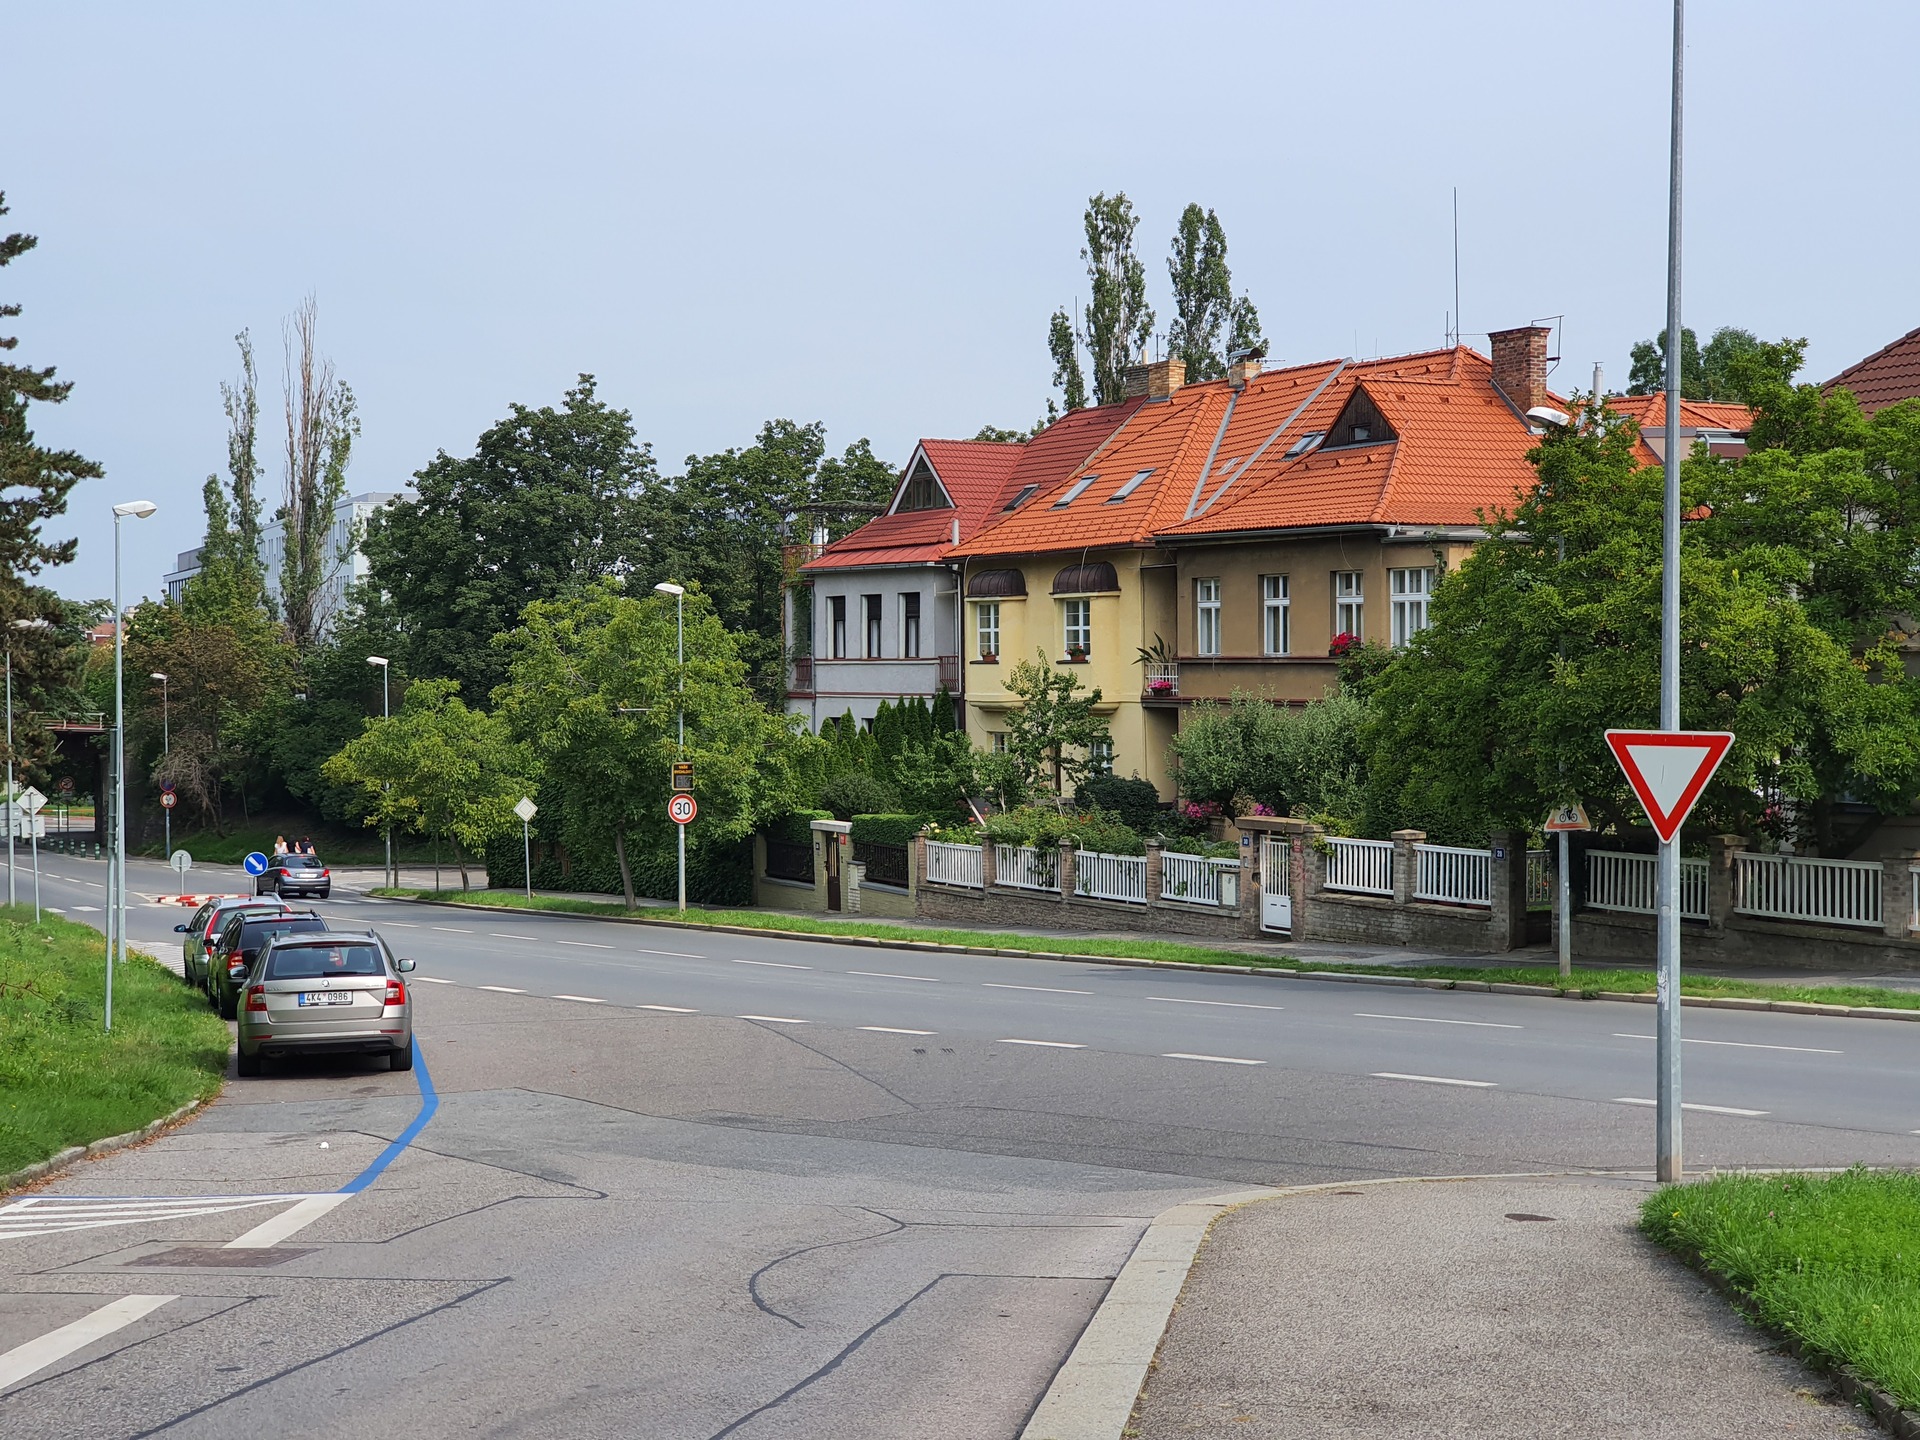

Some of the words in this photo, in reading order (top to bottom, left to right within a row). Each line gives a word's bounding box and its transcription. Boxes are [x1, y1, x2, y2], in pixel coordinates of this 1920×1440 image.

[675, 802, 690, 815] 30
[306, 993, 321, 1002] 4K4
[327, 992, 348, 1001] 0986
